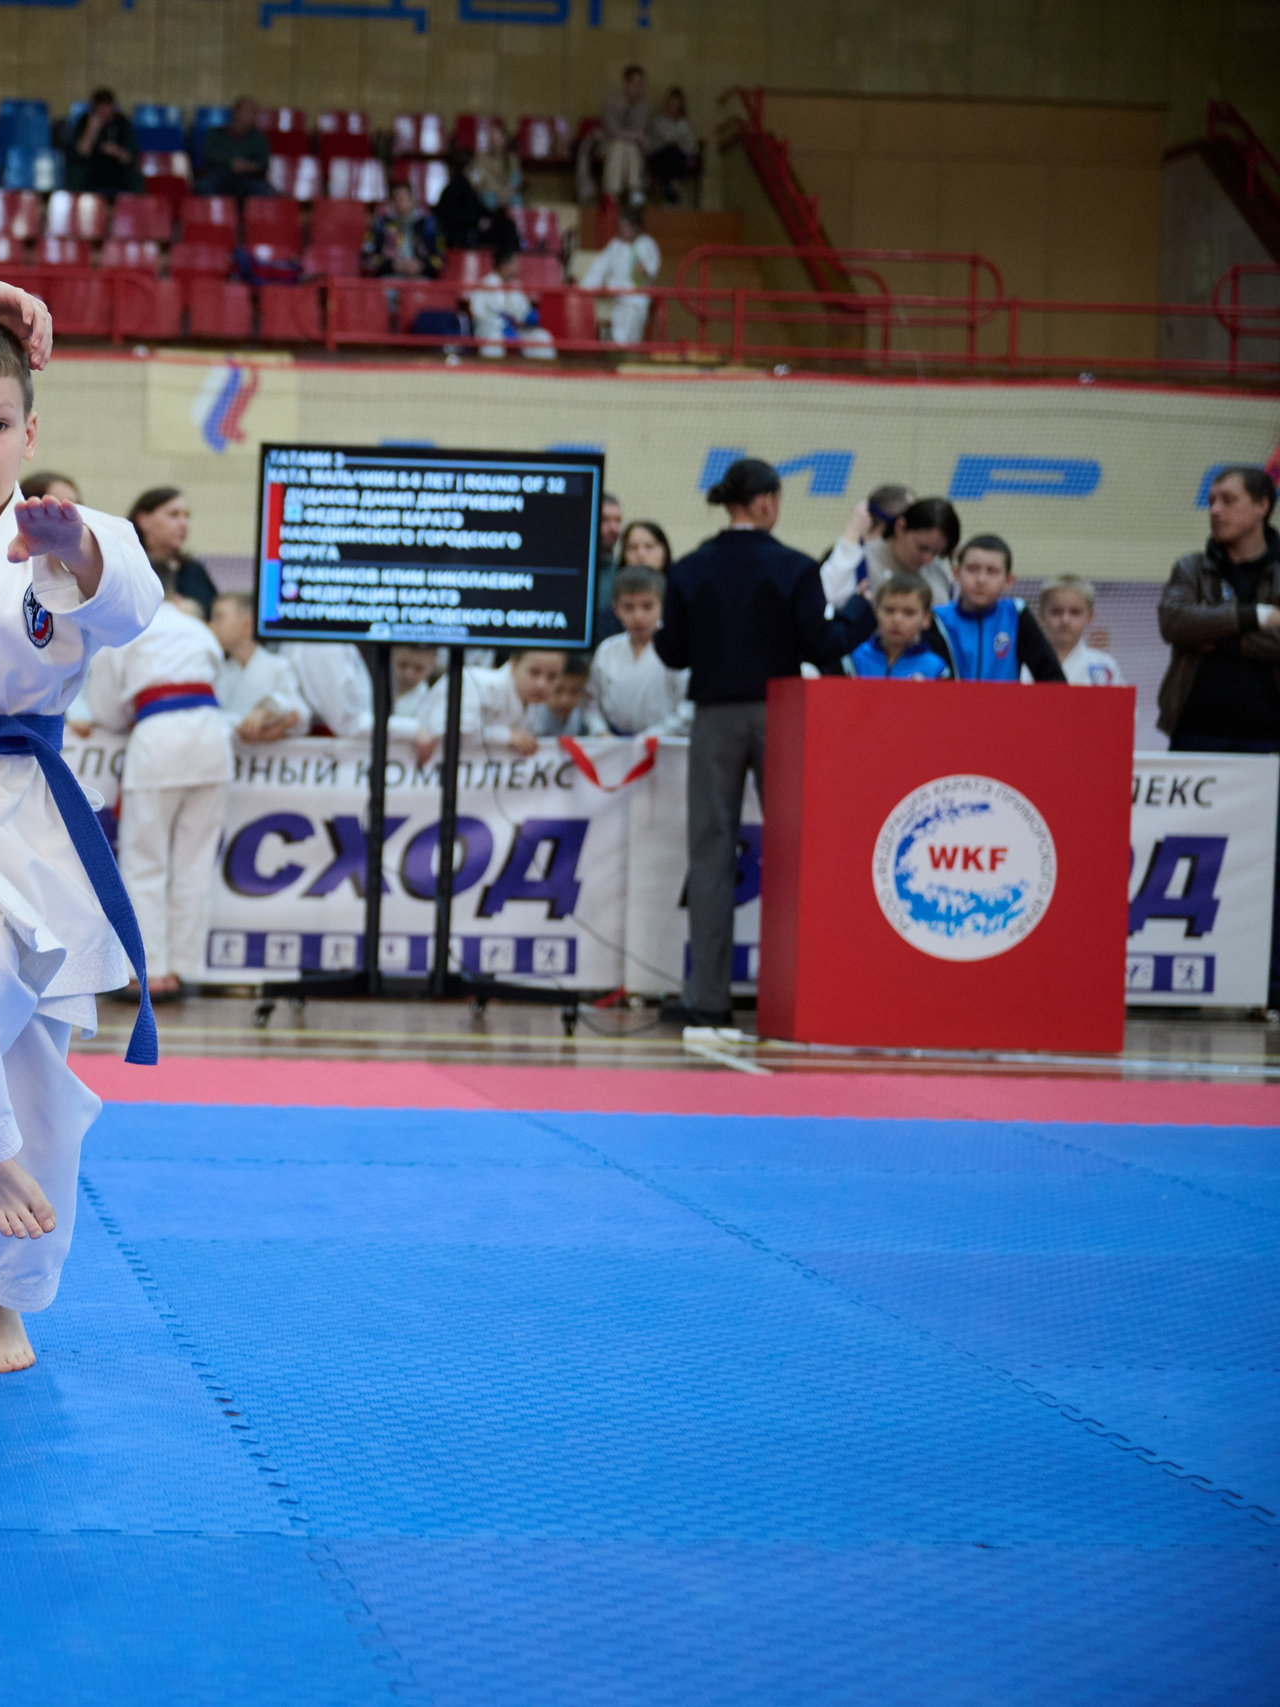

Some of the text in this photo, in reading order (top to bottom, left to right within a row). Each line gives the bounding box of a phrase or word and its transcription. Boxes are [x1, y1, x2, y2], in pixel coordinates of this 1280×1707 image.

[268, 467, 309, 485] КАТА
[310, 469, 397, 488] МАЛЬЧИКИ
[464, 473, 522, 492] ROUND
[521, 475, 546, 493] OF
[303, 506, 465, 530] ФЕДЕРАЦИЯ КАРАТЭ
[278, 542, 341, 562] ОКРУГА
[416, 529, 523, 551] ГОРОДСКОГО
[426, 569, 534, 592] НИКОЛАЕВИЧ
[299, 584, 462, 607] ФЕДЕРАЦИЯ КАРАТЭ
[400, 605, 507, 628] ГОРОДСКОГО
[506, 609, 569, 630] ОКРУГА
[218, 812, 589, 920] СХОД
[928, 845, 1008, 872] WKF
